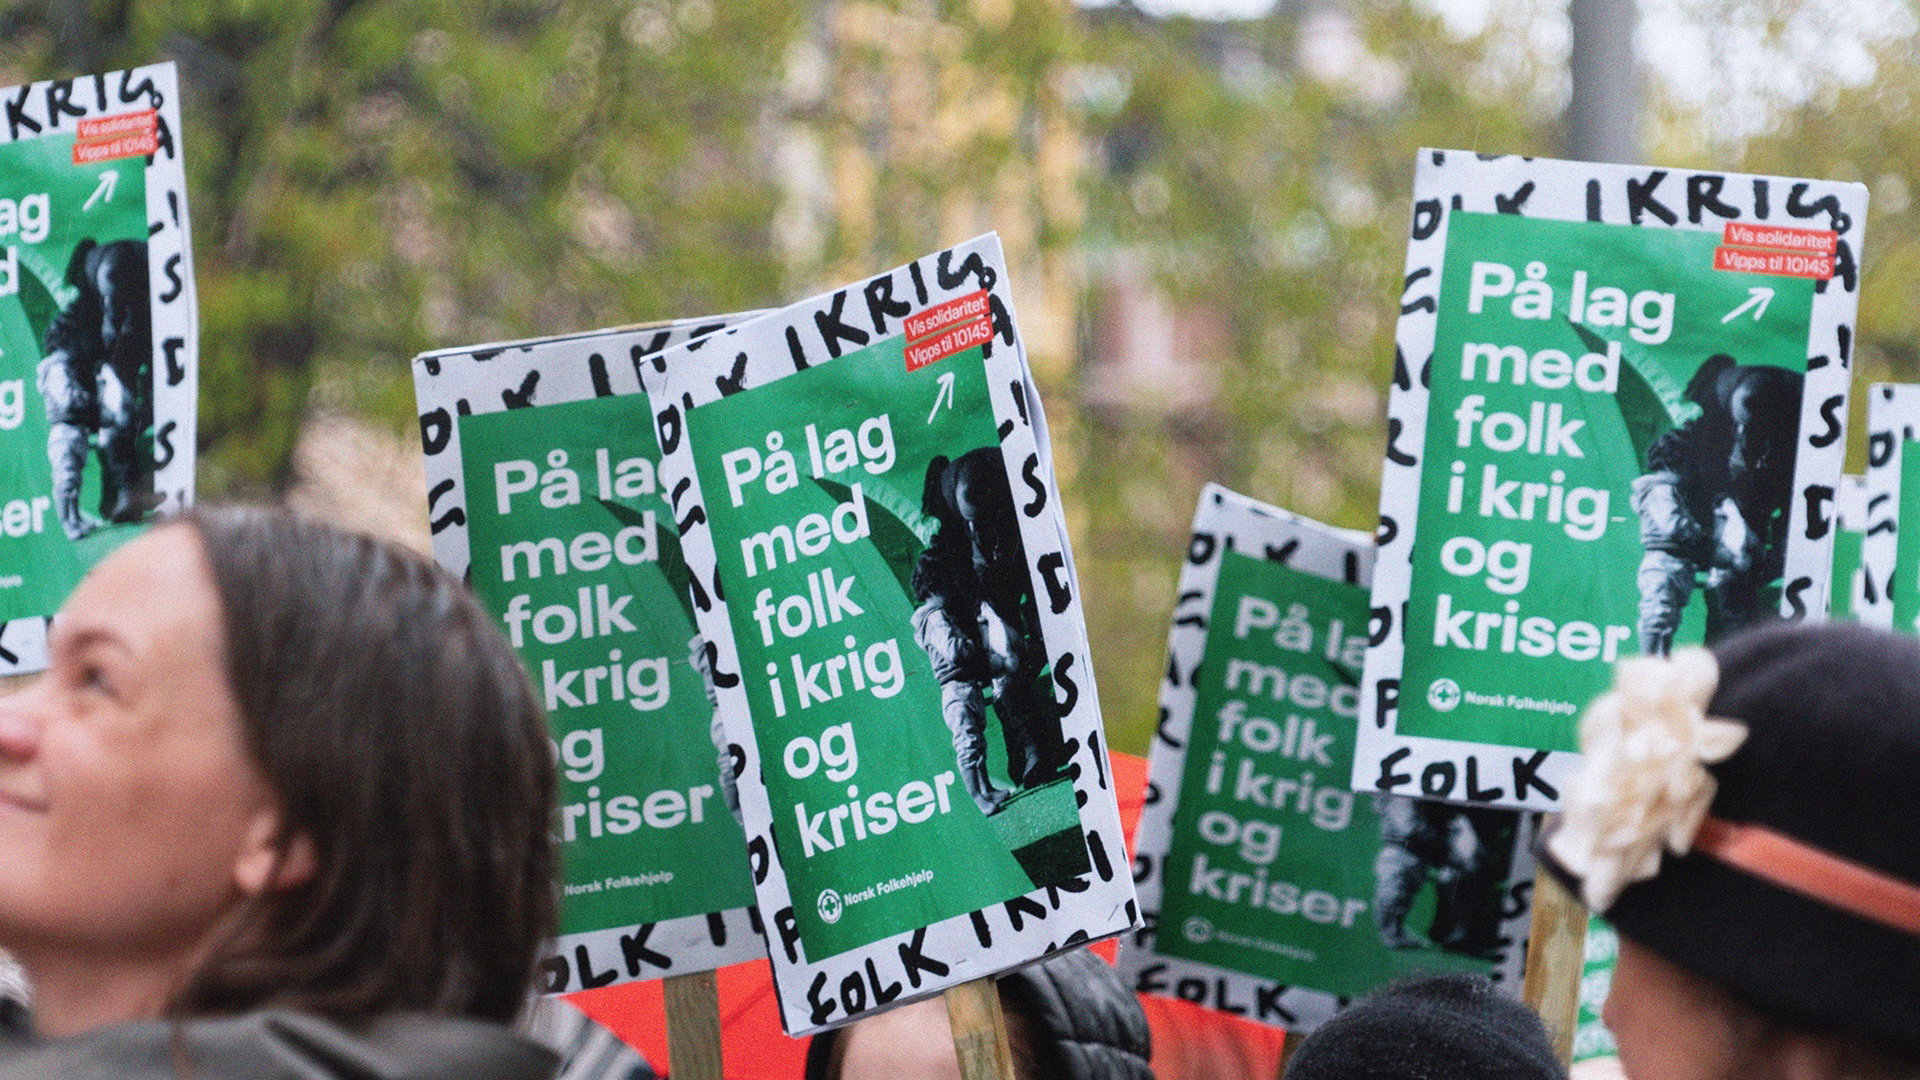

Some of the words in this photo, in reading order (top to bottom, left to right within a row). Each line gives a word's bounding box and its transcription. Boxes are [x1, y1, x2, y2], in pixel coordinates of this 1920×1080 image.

[0, 193, 49, 244] ag
[1731, 225, 1755, 243] Vis
[1756, 230, 1833, 249] solidaritet
[1723, 250, 1767, 269] Vipps
[1769, 257, 1783, 271] til
[1786, 257, 1831, 275] 10145
[908, 320, 926, 337] Vis
[927, 297, 986, 329] solidaritet
[1467, 261, 1553, 320] På
[1569, 270, 1675, 344] lag
[909, 344, 941, 366] Vipps
[941, 335, 953, 352] til
[953, 321, 990, 347] 10145
[1460, 341, 1621, 394] med
[1454, 394, 1586, 458] folk
[494, 449, 580, 514] På
[721, 431, 799, 508] På
[805, 413, 896, 479] lag
[740, 483, 870, 578] med
[1446, 461, 1466, 514] i
[1479, 465, 1611, 541] krig
[500, 510, 658, 581] med
[1439, 536, 1533, 594] og
[503, 584, 637, 648] folk
[753, 567, 864, 647] folk
[1233, 595, 1313, 653] På
[1324, 619, 1368, 668] la
[1432, 594, 1631, 664] kriser
[542, 649, 671, 711] krig
[766, 662, 786, 718] i
[790, 635, 905, 709] krig
[1464, 690, 1505, 707] Norsk
[1507, 695, 1577, 716] Folkehjelp
[783, 722, 859, 782] og
[1216, 699, 1334, 767] folk
[1205, 744, 1227, 795] i
[1235, 757, 1356, 831] krig
[1375, 748, 1559, 802] FOLK
[550, 785, 714, 843] riser
[794, 770, 955, 858] kriser
[1197, 811, 1282, 865] og
[564, 880, 603, 896] Norsk
[605, 870, 674, 890] Folkehjelp
[843, 886, 875, 907] Norsk
[876, 869, 934, 896] Folkehjelp
[1188, 855, 1368, 929] kriser
[535, 921, 672, 995] OLK
[806, 926, 949, 1025] FOLK
[1136, 964, 1298, 1025] FOLK
